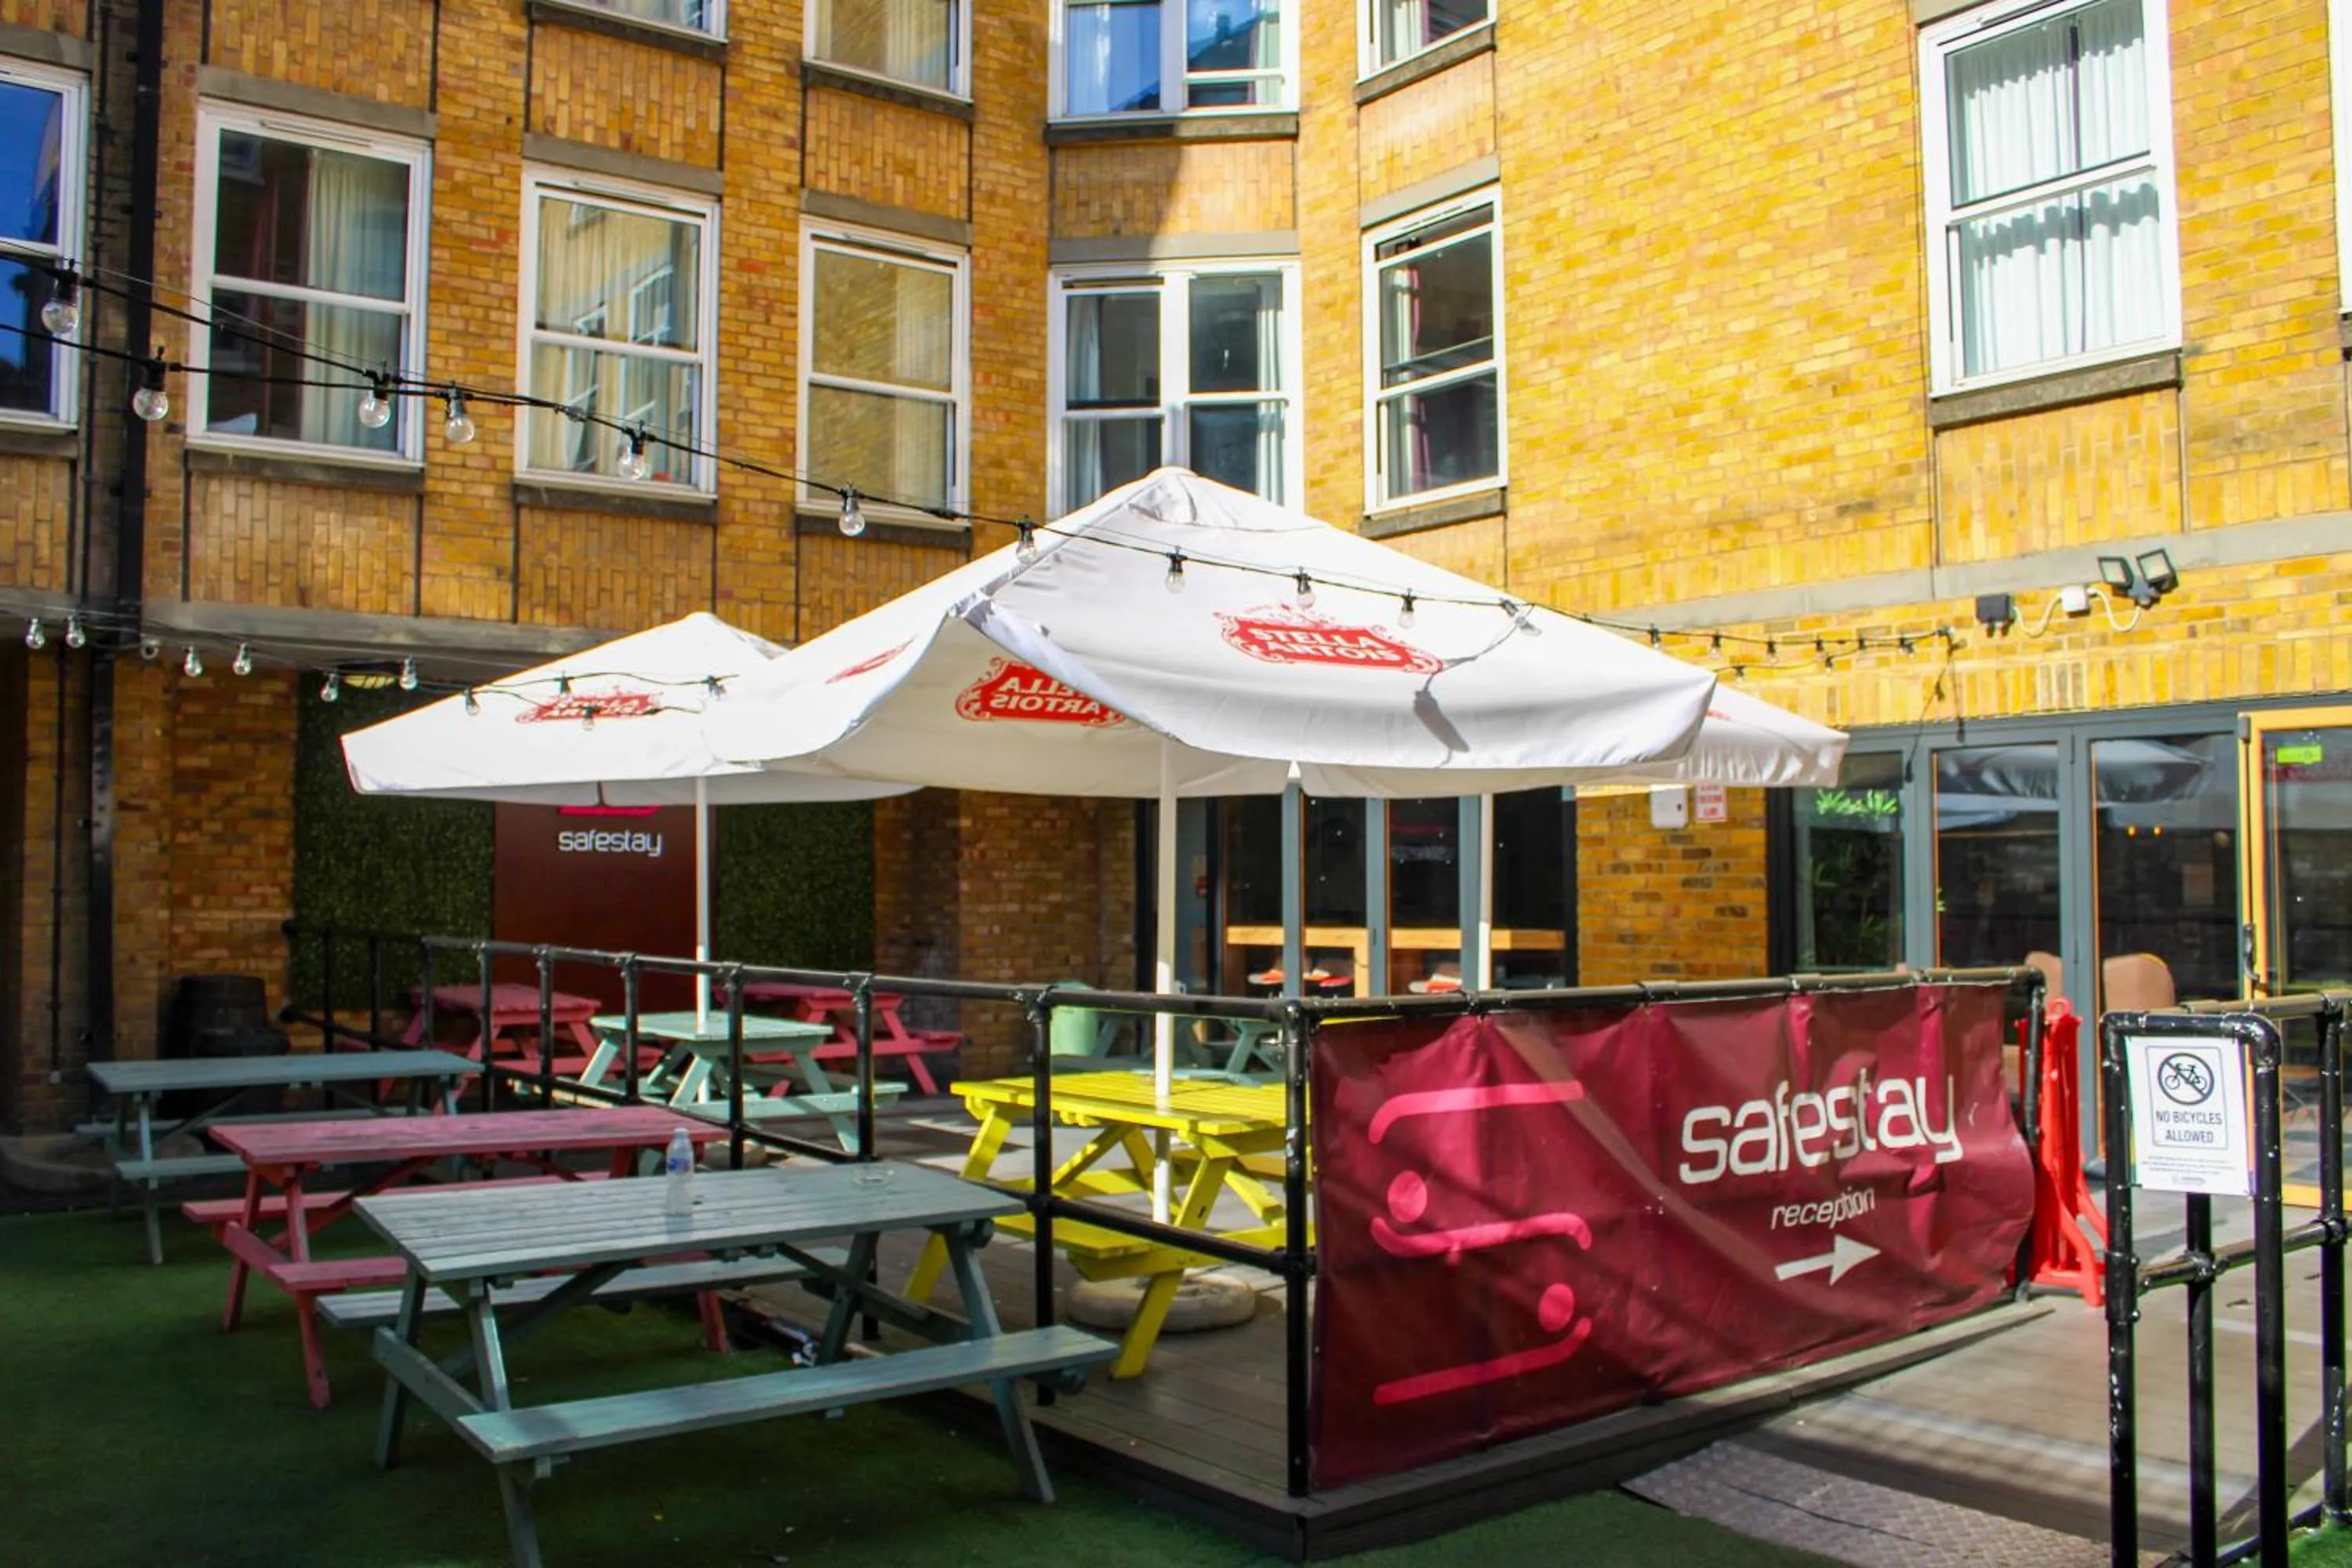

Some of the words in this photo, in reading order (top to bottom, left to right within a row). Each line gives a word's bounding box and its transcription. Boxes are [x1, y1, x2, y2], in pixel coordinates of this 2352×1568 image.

[1250, 628, 1386, 649] STELLA
[1266, 642, 1401, 661] ARTOIS
[558, 829, 662, 857] safestay
[1679, 1067, 1964, 1185] safestay
[2156, 1111, 2169, 1123] NO
[2174, 1112, 2222, 1125] BICYCLES
[2165, 1130, 2214, 1143] ALLOWED
[1770, 1185, 1876, 1230] reception
